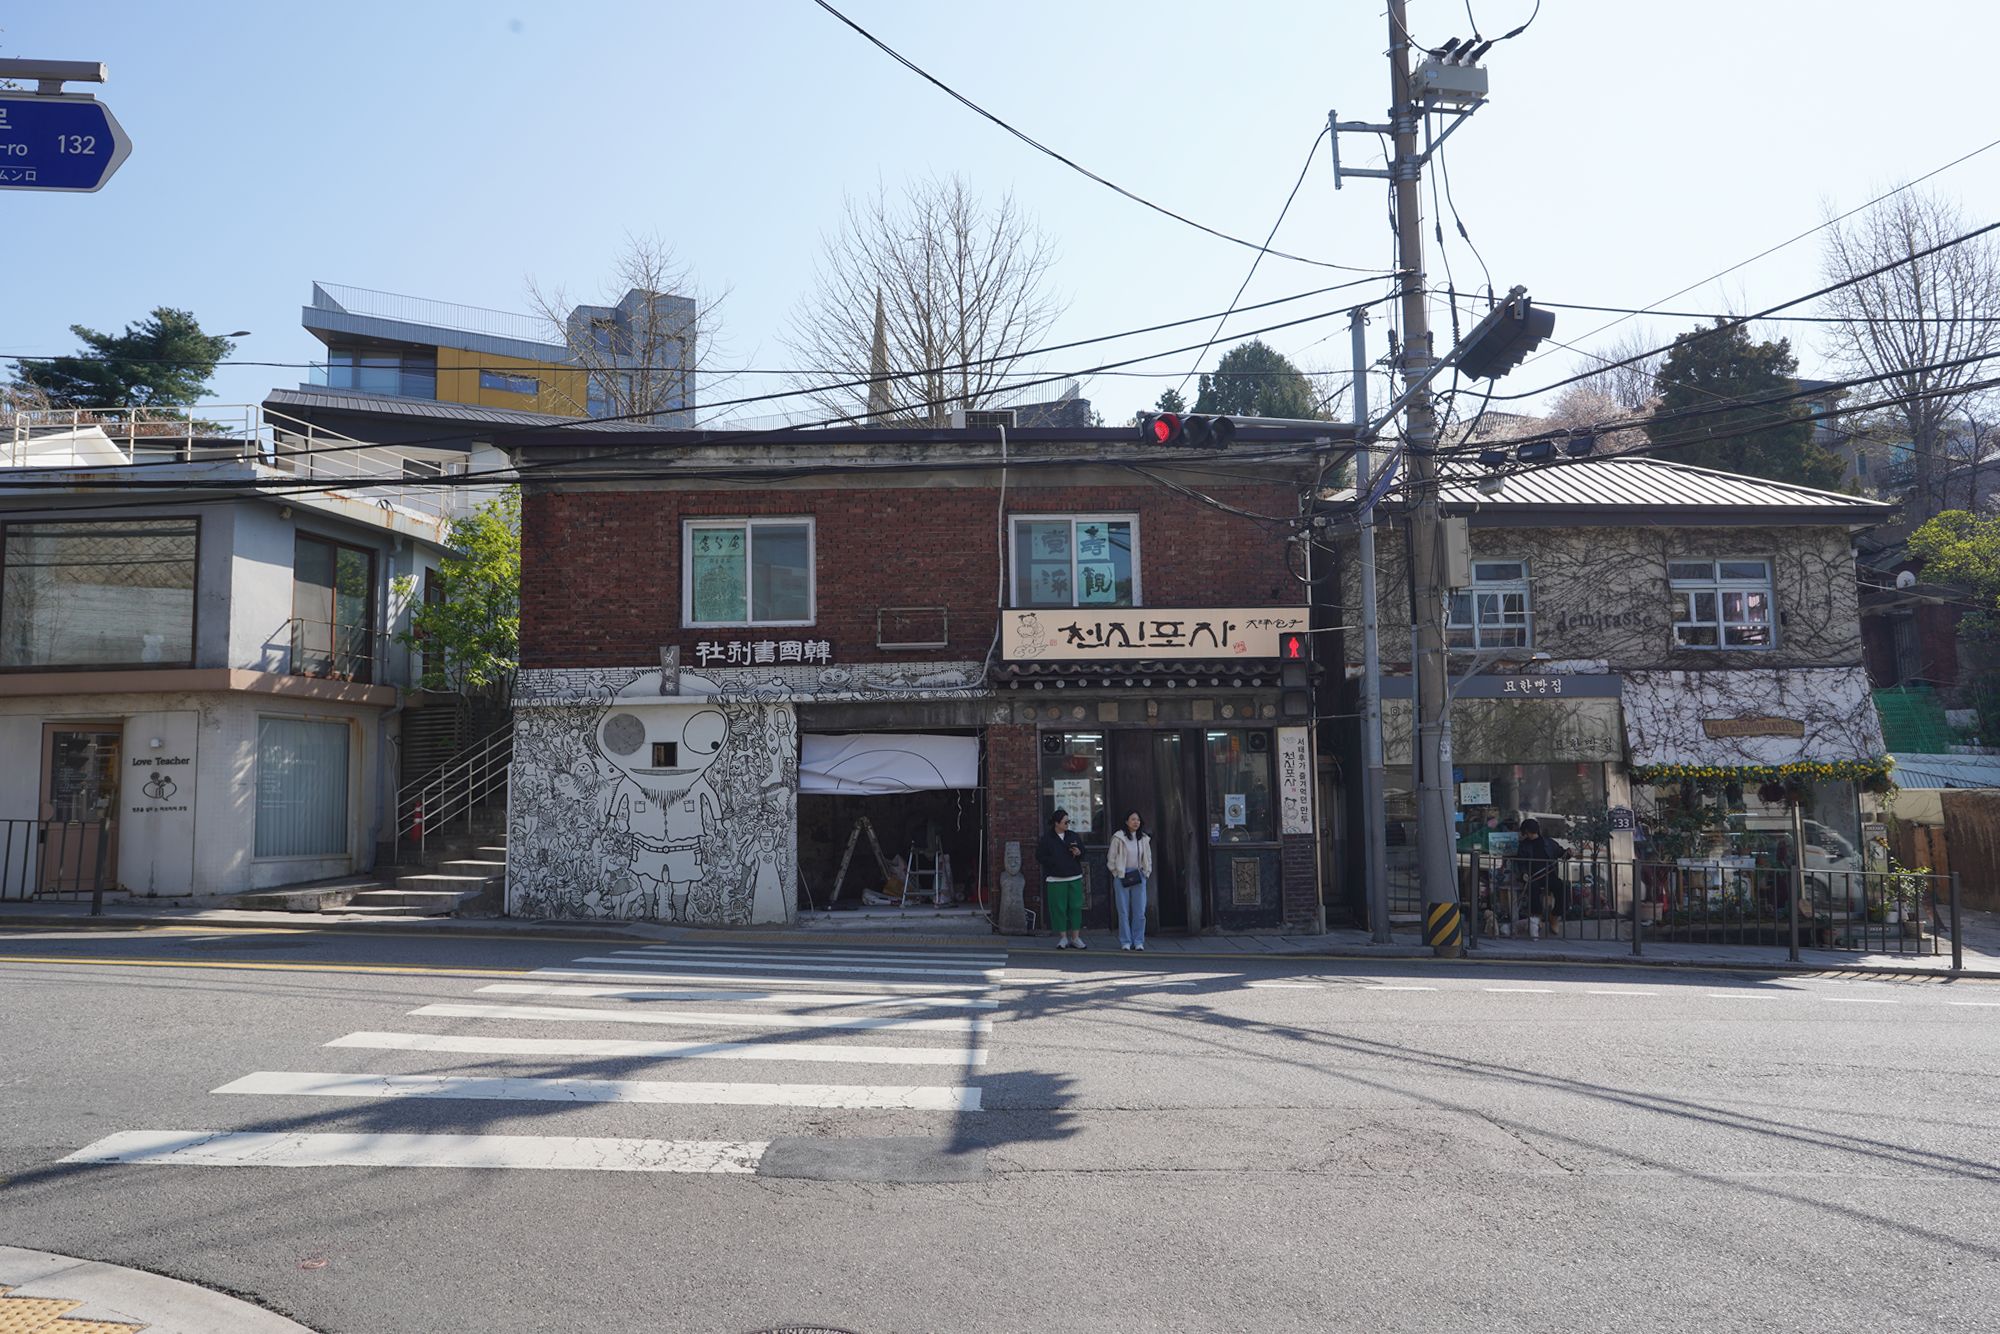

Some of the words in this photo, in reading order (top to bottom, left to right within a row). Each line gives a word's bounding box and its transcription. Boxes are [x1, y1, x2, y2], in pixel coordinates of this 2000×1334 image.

[57, 134, 96, 154] 132
[1503, 678, 1562, 694] 묘한빵집
[132, 757, 153, 766] Love
[155, 756, 190, 765] Teacher
